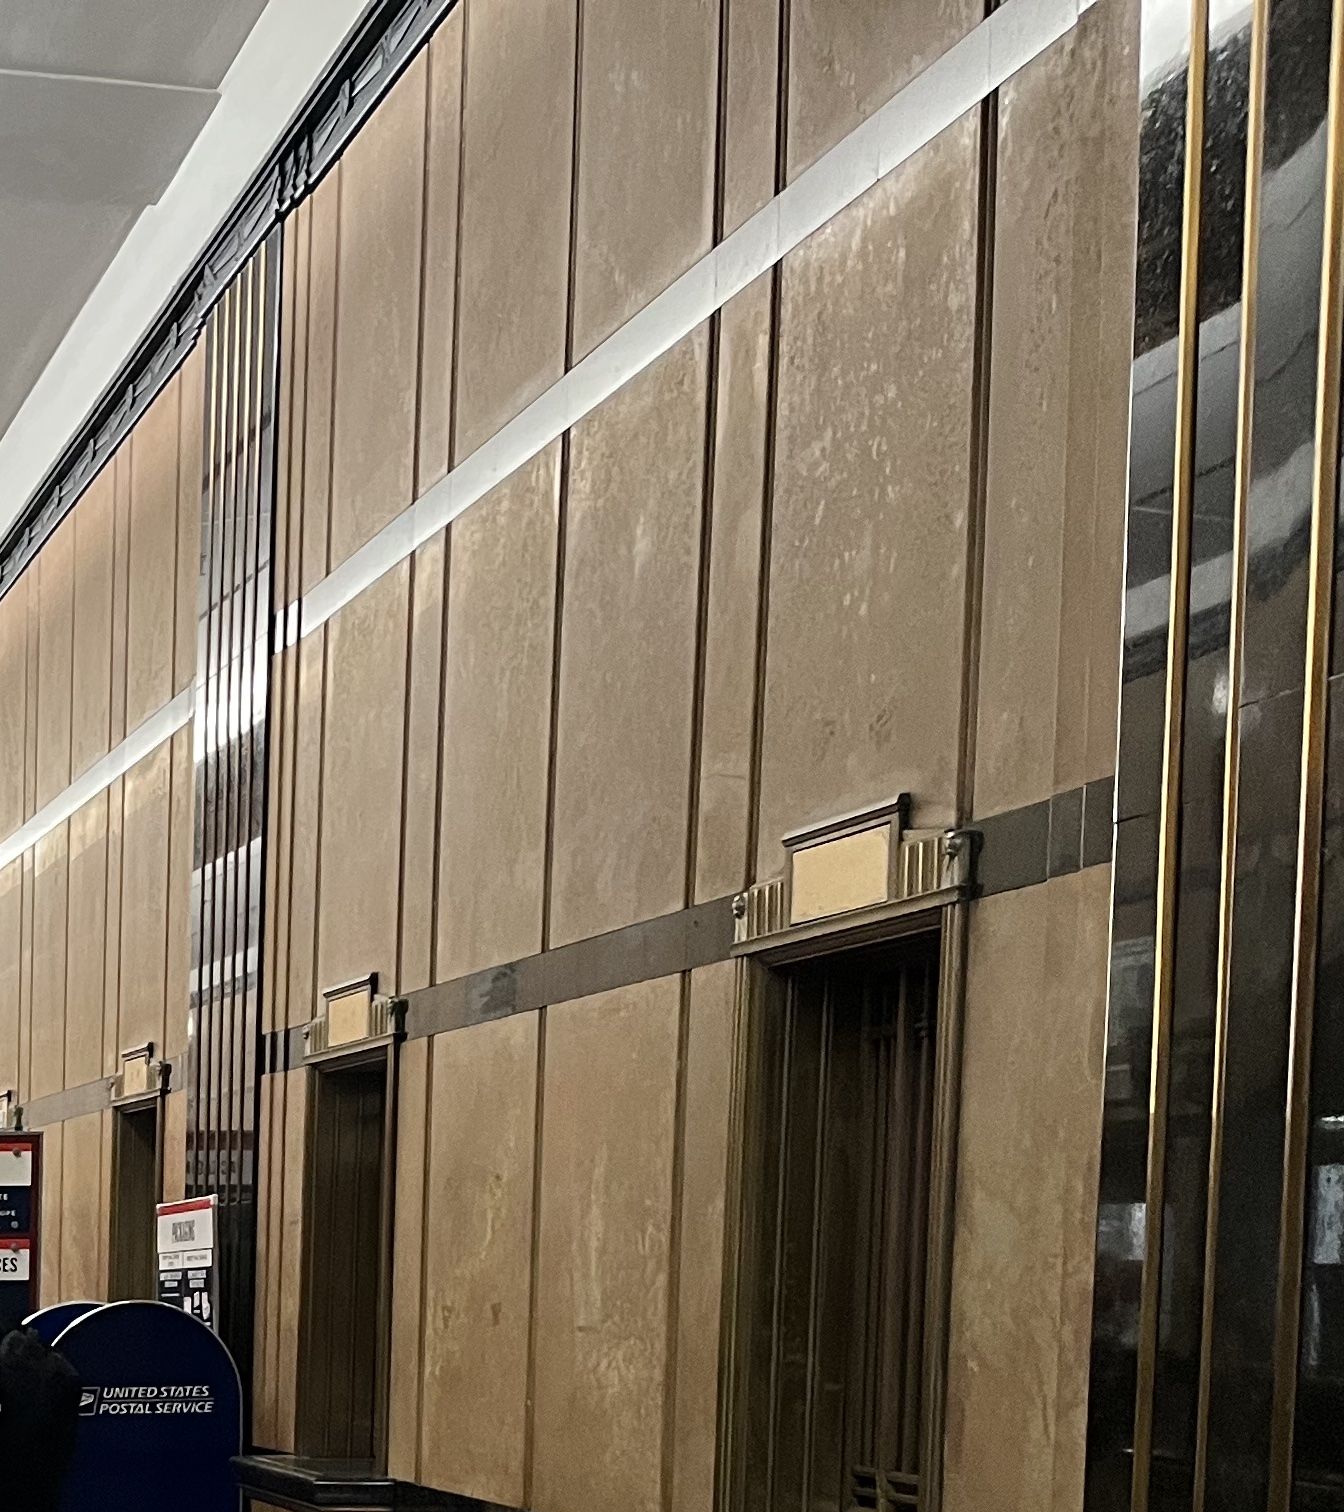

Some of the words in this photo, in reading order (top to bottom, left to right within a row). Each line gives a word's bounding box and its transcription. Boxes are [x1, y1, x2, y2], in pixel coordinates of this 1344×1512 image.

[102, 1386, 158, 1399] UNITED
[159, 1385, 210, 1398] STATES
[99, 1402, 154, 1415] POSTAL
[155, 1401, 214, 1414] SERVICE
